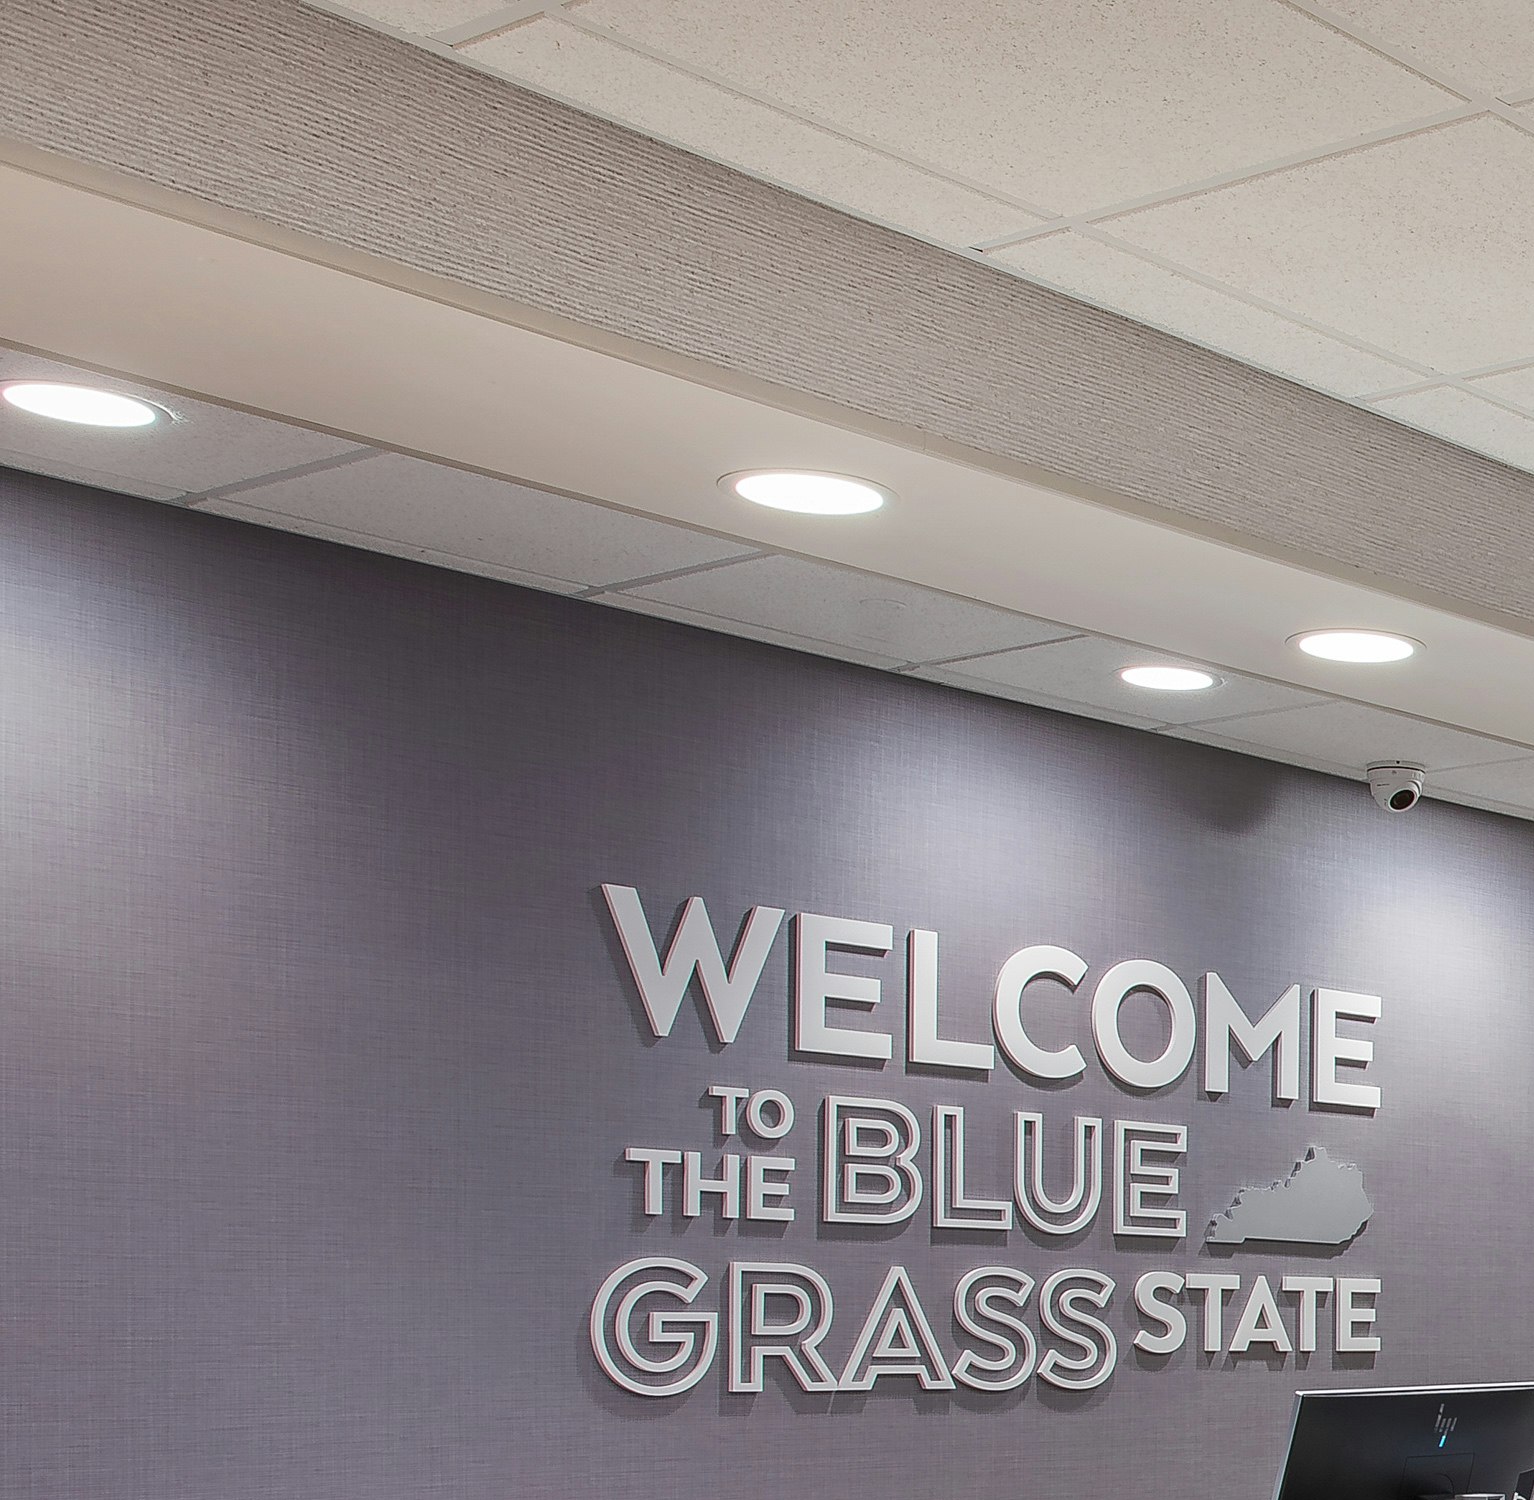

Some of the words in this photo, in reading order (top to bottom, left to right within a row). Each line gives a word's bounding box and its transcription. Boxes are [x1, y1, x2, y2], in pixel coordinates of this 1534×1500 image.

[601, 883, 1382, 1110] WELCOME
[624, 1147, 795, 1222] THE
[822, 1095, 1188, 1237] BLUE
[708, 1086, 794, 1140] TO
[589, 1256, 1117, 1397] GRASS
[1134, 1271, 1382, 1353] STATE
